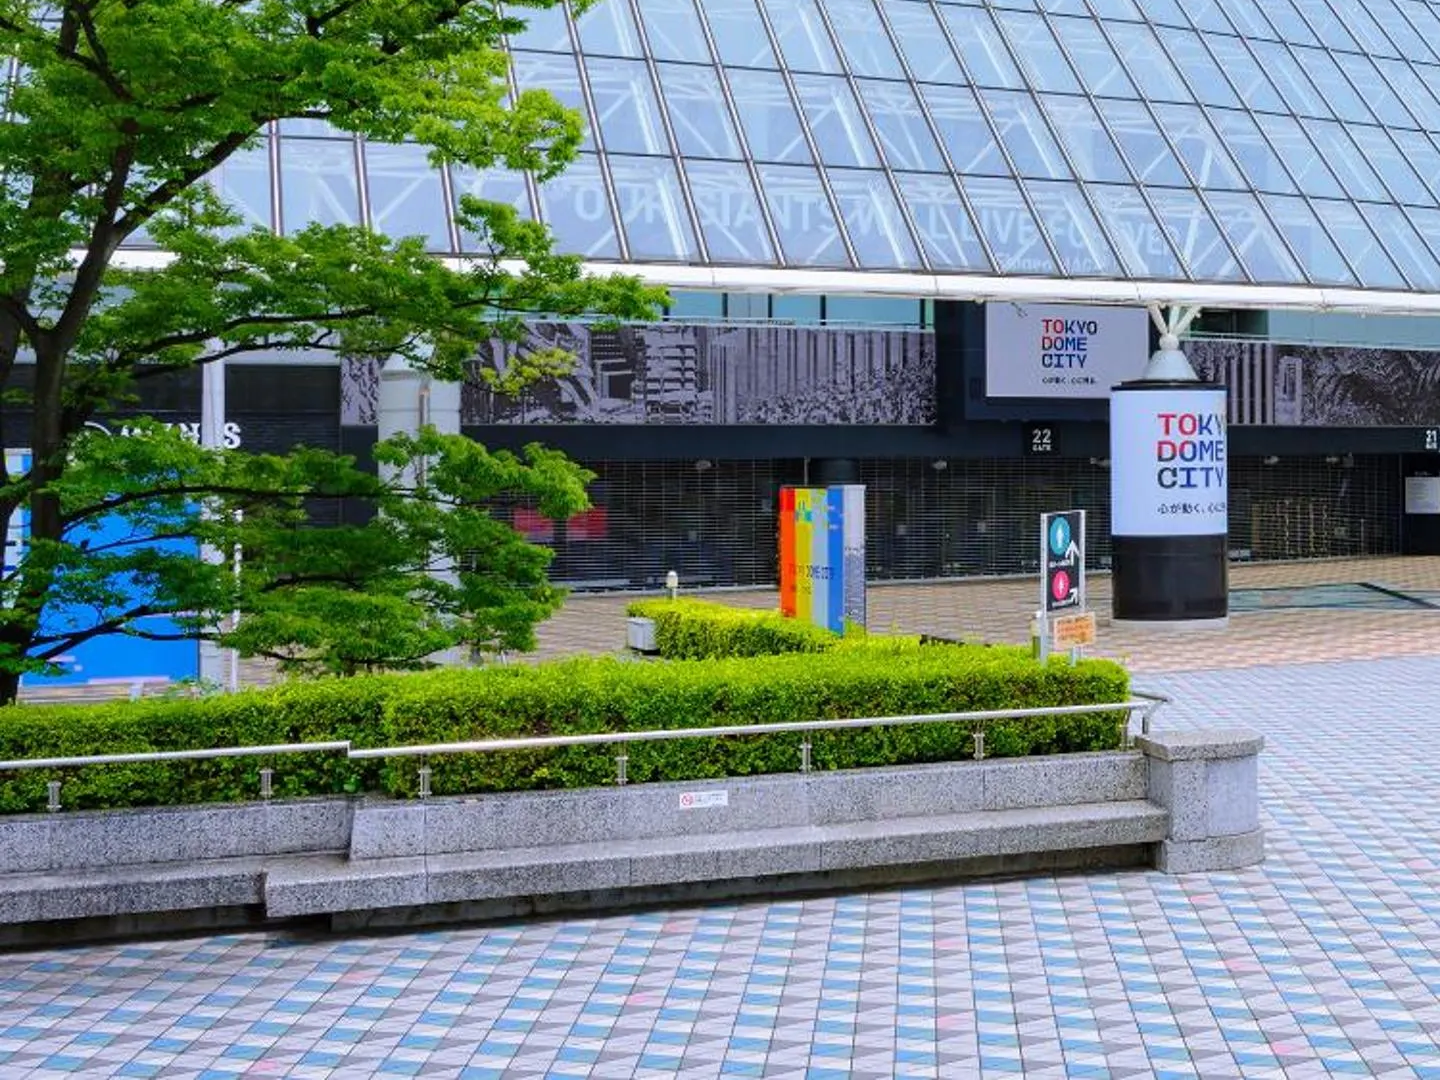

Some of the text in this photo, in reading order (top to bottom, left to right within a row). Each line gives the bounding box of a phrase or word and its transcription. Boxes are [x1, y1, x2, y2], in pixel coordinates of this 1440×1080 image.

[1042, 320, 1098, 336] TOKYO
[1042, 336, 1088, 351] DOME
[1042, 353, 1088, 369] CITY
[1032, 428, 1051, 443] 22
[1157, 440, 1225, 463] DOME
[1157, 467, 1225, 489] CITY
